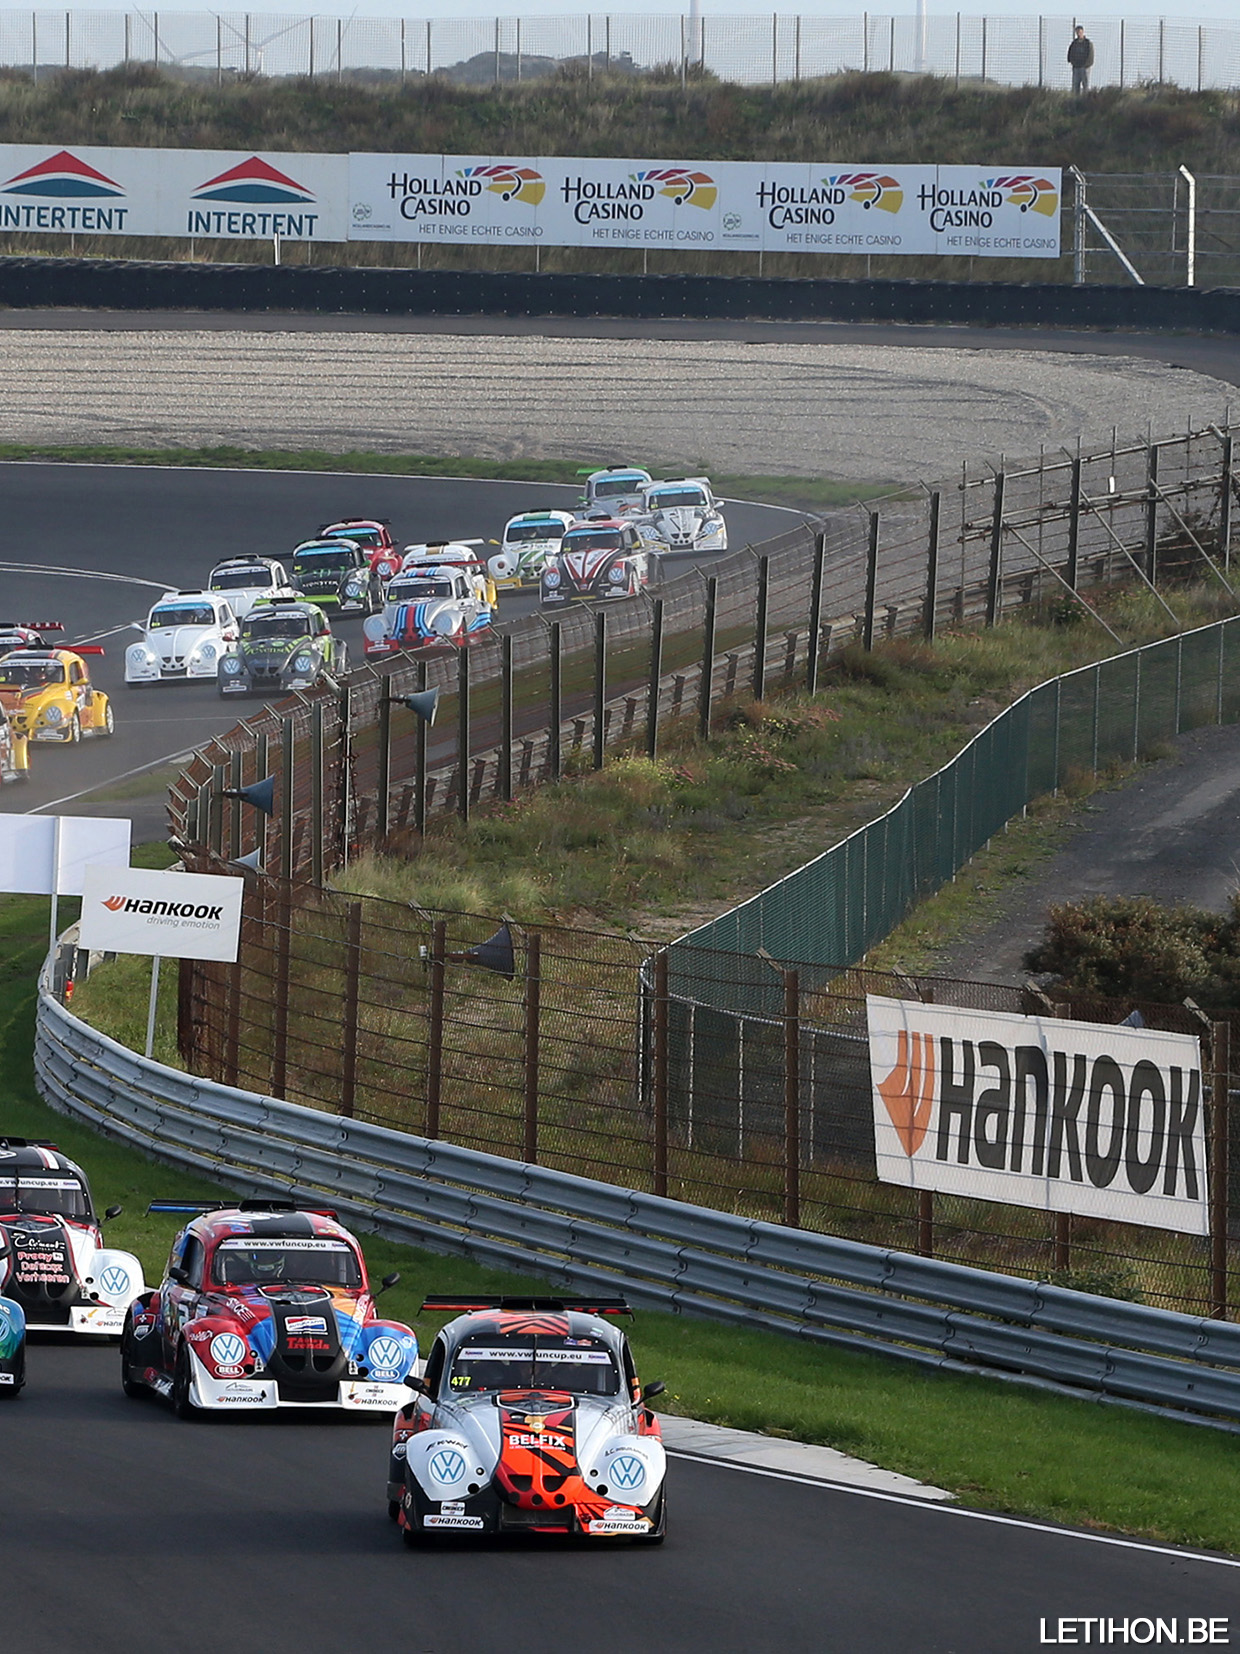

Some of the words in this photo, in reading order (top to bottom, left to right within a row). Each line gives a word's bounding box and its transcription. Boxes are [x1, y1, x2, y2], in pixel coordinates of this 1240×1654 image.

[386, 172, 482, 199] HOLLAND
[560, 176, 655, 203] HOLLAND
[755, 181, 846, 208] HOLLAND
[916, 183, 1003, 211] HOLLAND
[400, 196, 471, 220] CASINO
[574, 200, 644, 225] CASINO
[768, 205, 835, 230] CASINO
[929, 208, 993, 232] CASINO
[188, 210, 318, 237] INTERTENT
[418, 223, 437, 235] HET
[439, 224, 469, 236] ENIGE
[471, 225, 502, 237] ECHTE
[504, 226, 544, 238] CASINO
[592, 228, 610, 239] HET
[611, 228, 641, 240] ENIGE
[643, 229, 674, 241] ECHTE
[676, 230, 715, 242] CASINO
[786, 233, 803, 244] HET
[805, 233, 833, 245] ENIGE
[835, 234, 864, 246] ECHTE
[865, 234, 902, 246] CASINO
[947, 235, 963, 247] HET
[965, 236, 991, 248] ENIGE
[993, 237, 1022, 249] ECHTE
[1023, 237, 1057, 249] CASINO
[146, 915, 179, 928] driving
[181, 920, 221, 930] emotion
[243, 1241, 327, 1250] www.vwfuncup.eu
[450, 1376, 472, 1387] 477
[508, 1434, 566, 1447] BELFIX
